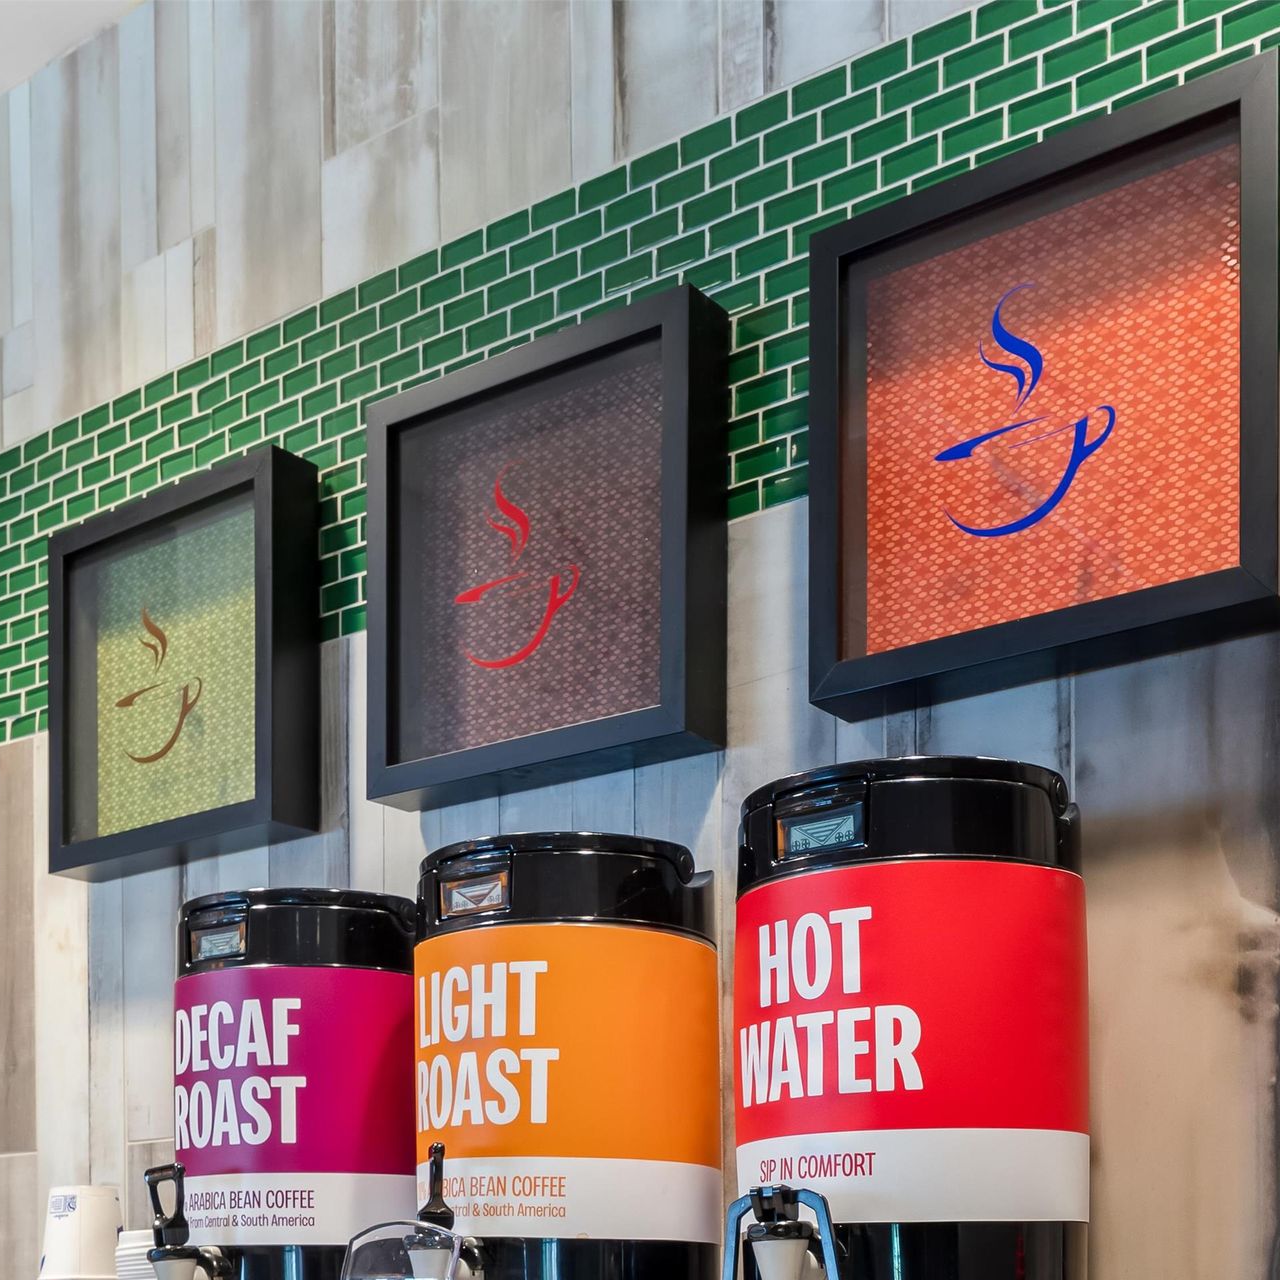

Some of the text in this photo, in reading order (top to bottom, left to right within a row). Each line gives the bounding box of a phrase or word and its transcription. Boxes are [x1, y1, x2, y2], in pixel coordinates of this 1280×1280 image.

[759, 906, 872, 1008] HOT
[175, 998, 302, 1075] DECAF
[419, 960, 548, 1049] LIGHT
[418, 1048, 560, 1133] ROAST
[740, 1004, 924, 1108] WATER
[175, 1076, 307, 1151] ROAST
[189, 1189, 315, 1212] ARABICA BEAN COFFEE
[470, 1176, 507, 1197] BEAN
[512, 1175, 566, 1197] COFFEE
[760, 1152, 876, 1183] SIP IN COMFORT
[205, 1214, 230, 1227] Central
[231, 1214, 239, 1227] &
[240, 1213, 269, 1227] South
[271, 1213, 315, 1227] America
[472, 1203, 480, 1217] &
[483, 1202, 514, 1217] South
[517, 1202, 566, 1218] America
